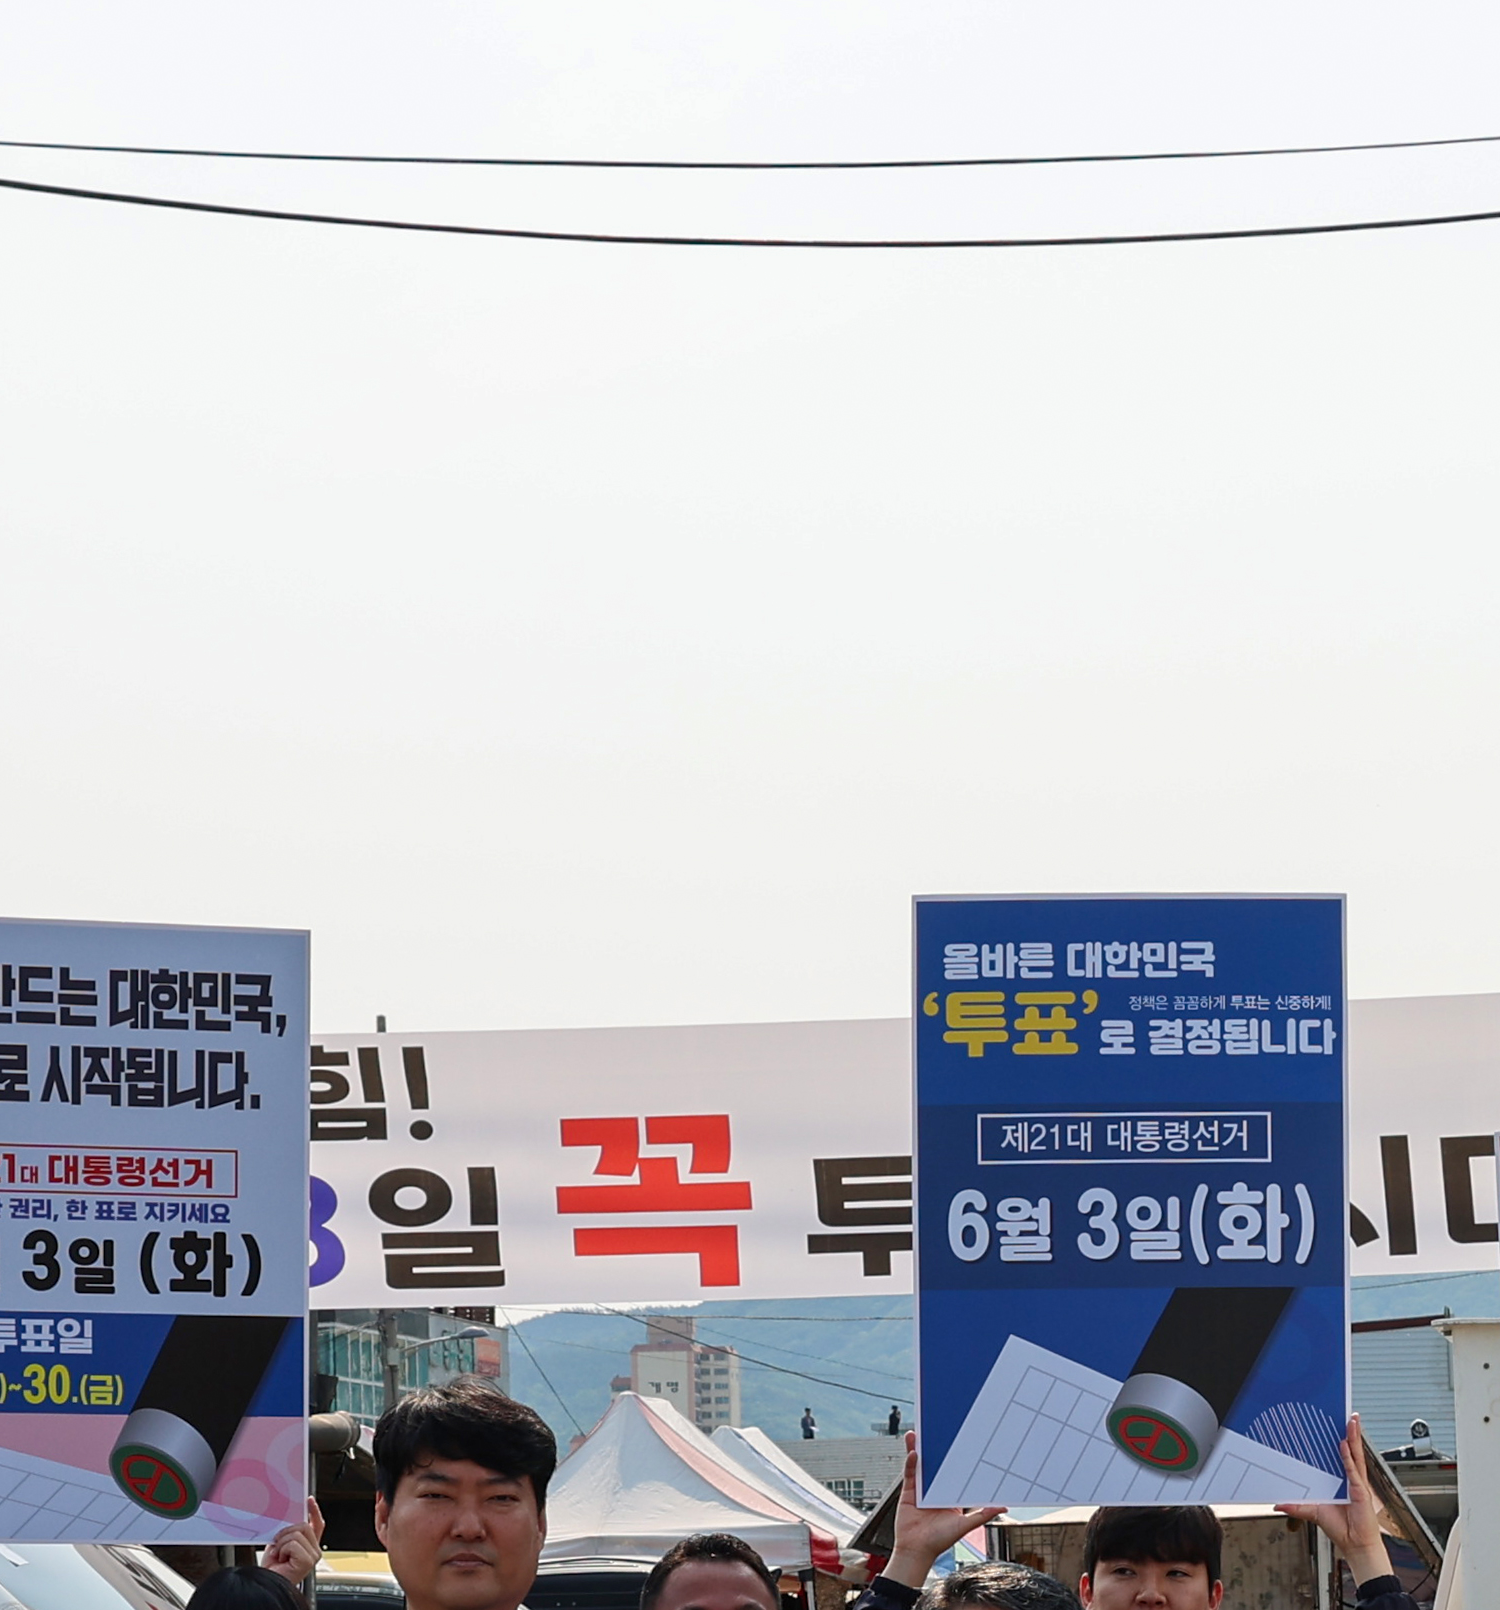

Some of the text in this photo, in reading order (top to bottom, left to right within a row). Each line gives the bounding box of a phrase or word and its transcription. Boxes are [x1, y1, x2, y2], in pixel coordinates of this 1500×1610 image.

[942, 941, 1216, 980] 올바른 대한민국
[108, 968, 288, 1038] 대한민국,
[1128, 993, 1333, 1011] 정책은 꼼꼼하게 투표는 신중하게!
[1148, 1018, 1337, 1057] 결정됩니다
[40, 1044, 262, 1111] 시작됩니다.
[1001, 1120, 1250, 1155] 제21대 대통령선거
[47, 1153, 215, 1190] 대통령선거
[8, 1197, 59, 1222] 권리,
[66, 1198, 88, 1222] 한
[93, 1200, 139, 1223] 표로
[143, 1200, 231, 1225] 지키세요
[555, 1114, 753, 1287] 꼭
[947, 1187, 1054, 1264] 6월
